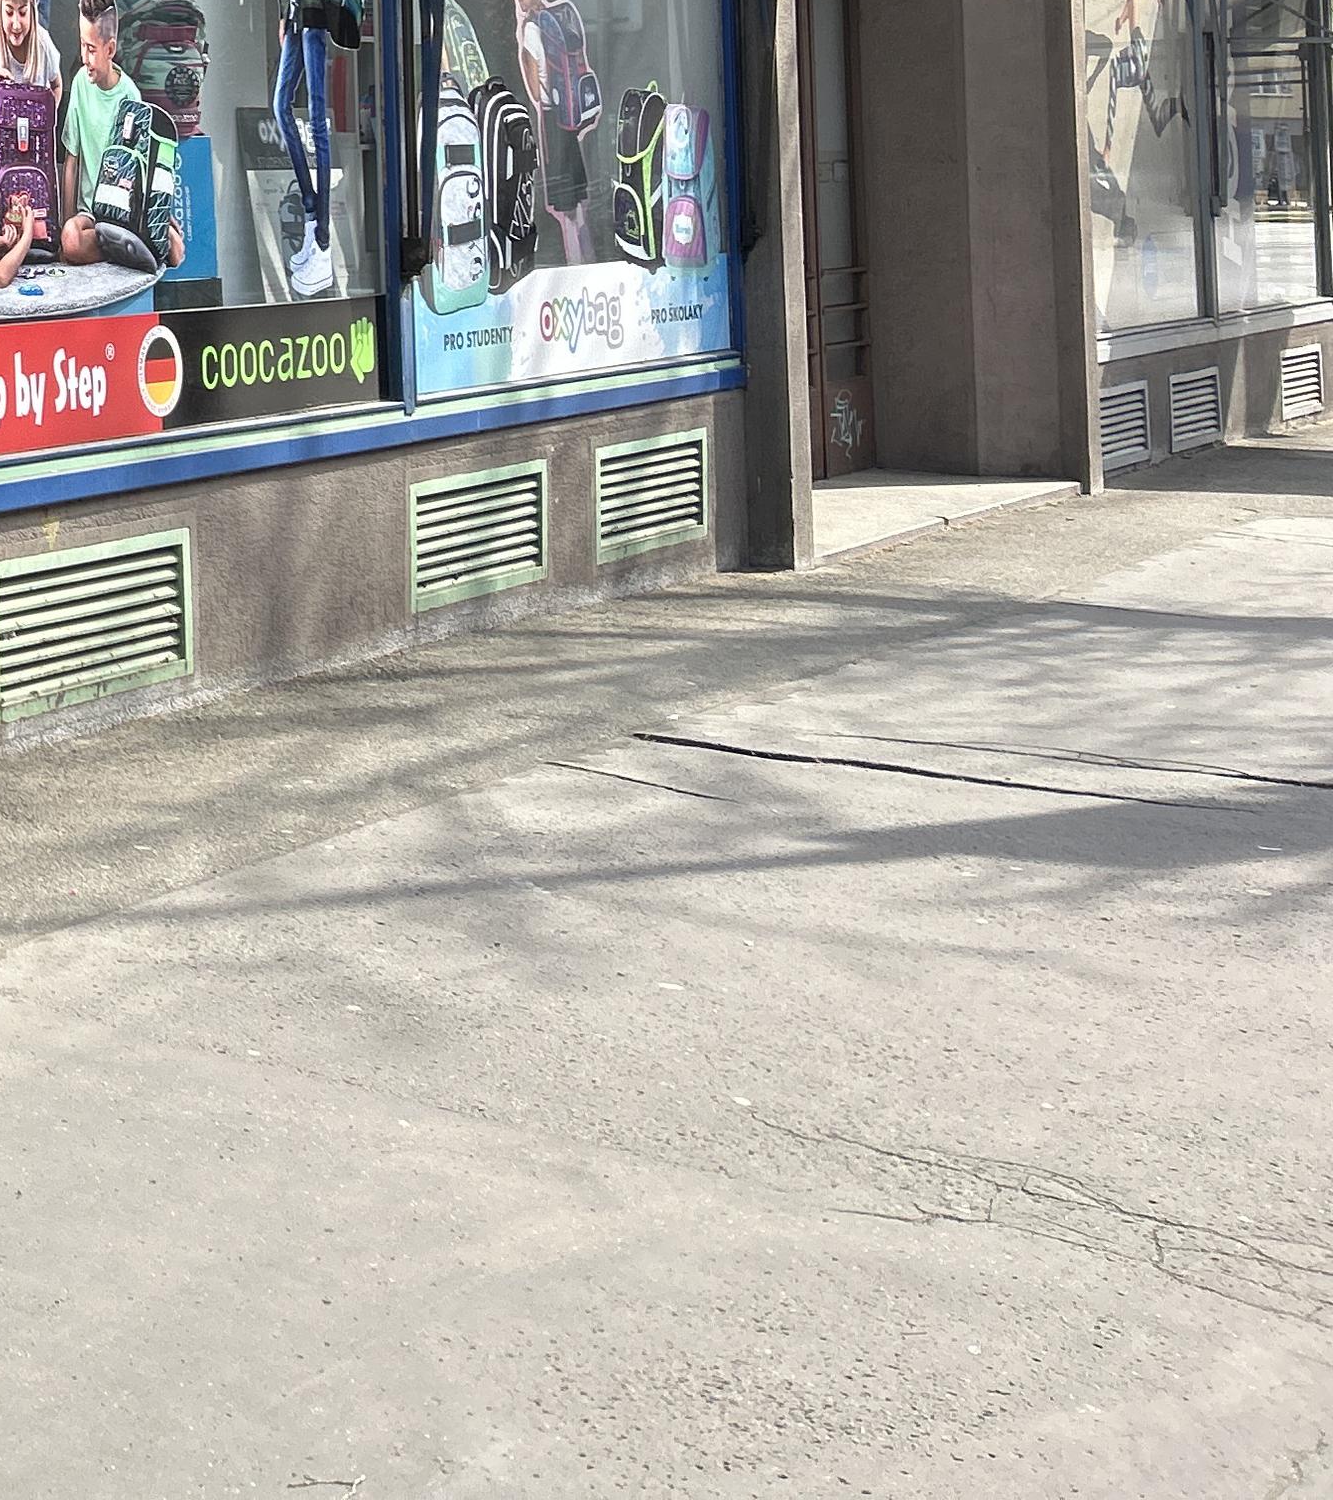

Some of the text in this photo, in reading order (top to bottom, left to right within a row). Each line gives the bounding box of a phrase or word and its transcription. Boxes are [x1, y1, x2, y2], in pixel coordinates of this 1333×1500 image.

[443, 325, 514, 351] PRO STUDENTY
[539, 285, 624, 353] oxybag
[650, 300, 703, 323] PRO ŠKOLÁKY
[14, 349, 47, 426] by
[53, 348, 107, 417] Step
[201, 331, 346, 391] coocazoo
